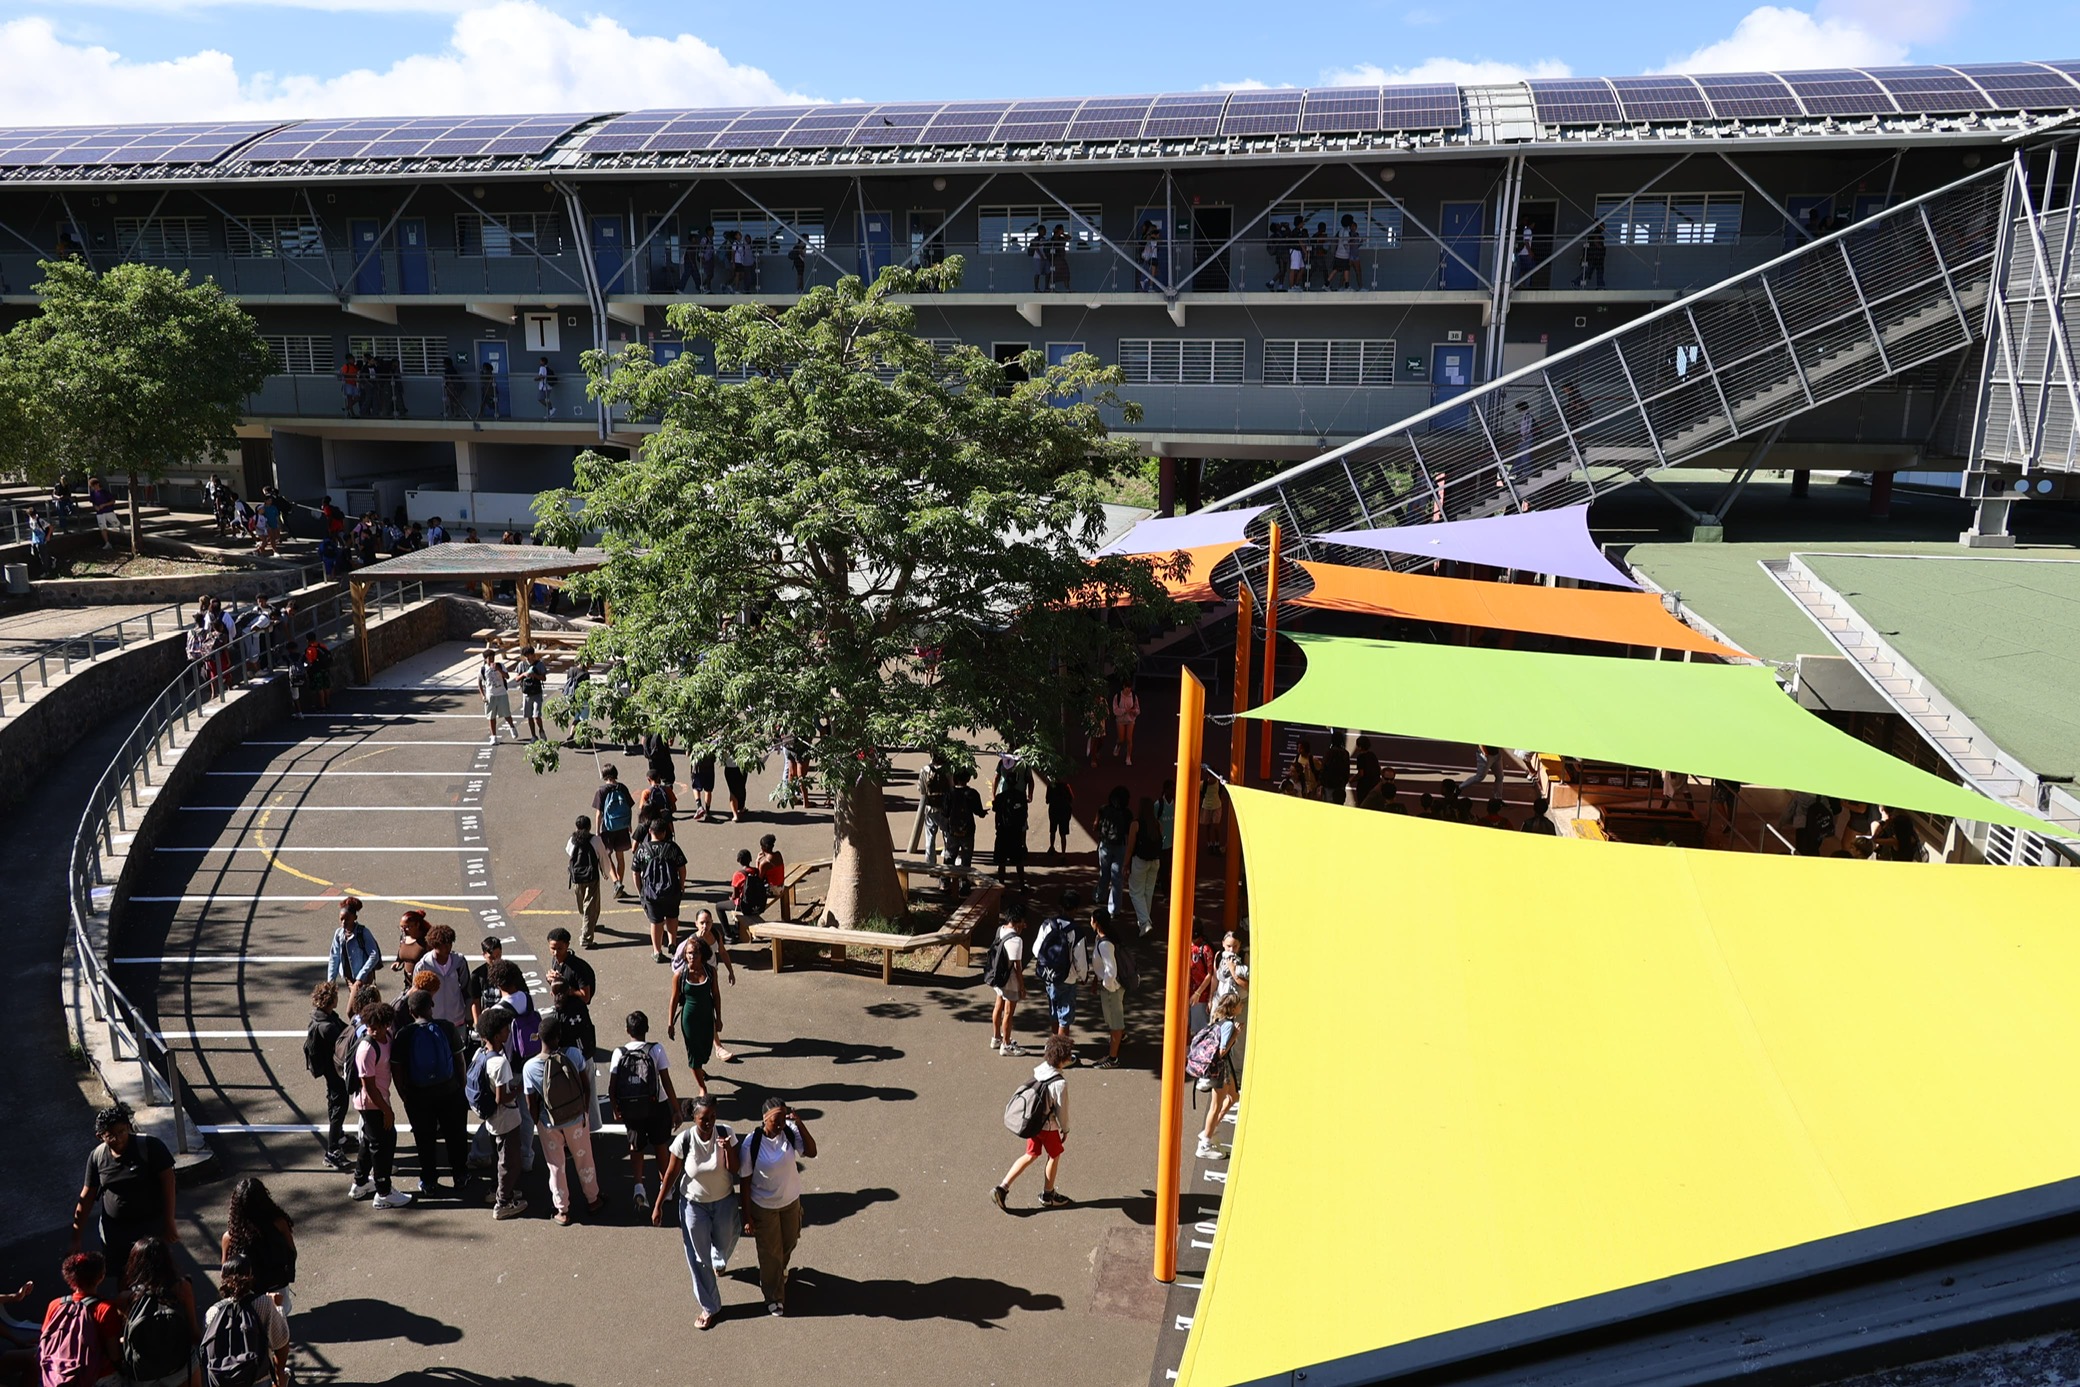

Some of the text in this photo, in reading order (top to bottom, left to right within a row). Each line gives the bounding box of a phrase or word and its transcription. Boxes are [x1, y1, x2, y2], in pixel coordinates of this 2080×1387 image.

[531, 316, 551, 347] T
[466, 780, 483, 792] 205
[462, 815, 479, 830] 206
[466, 858, 486, 875] 201
[479, 908, 506, 929] 202
[522, 971, 548, 996] 203
